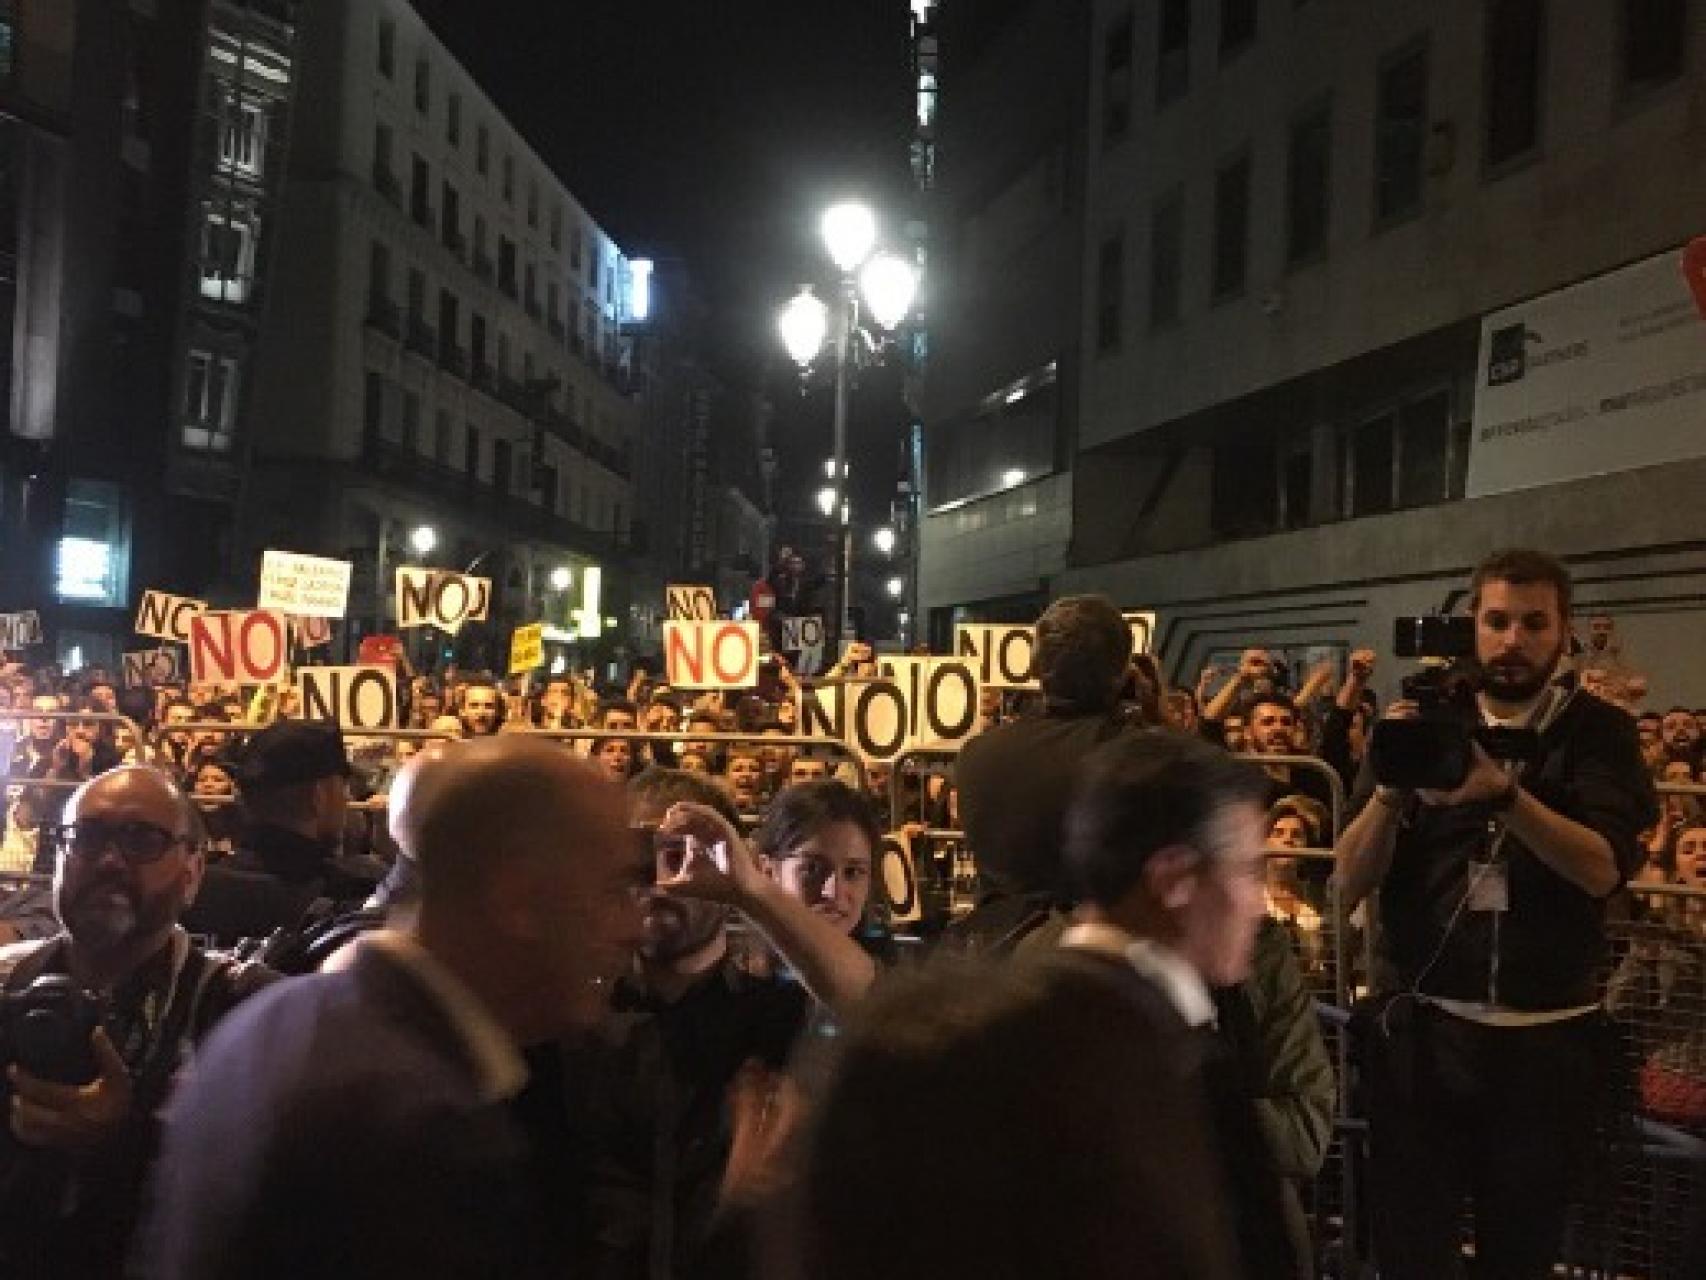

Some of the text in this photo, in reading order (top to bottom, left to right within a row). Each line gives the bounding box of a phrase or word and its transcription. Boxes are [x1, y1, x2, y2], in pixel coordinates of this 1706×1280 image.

[191, 610, 281, 680] NO
[668, 624, 752, 683] NO
[303, 670, 393, 727] NO
